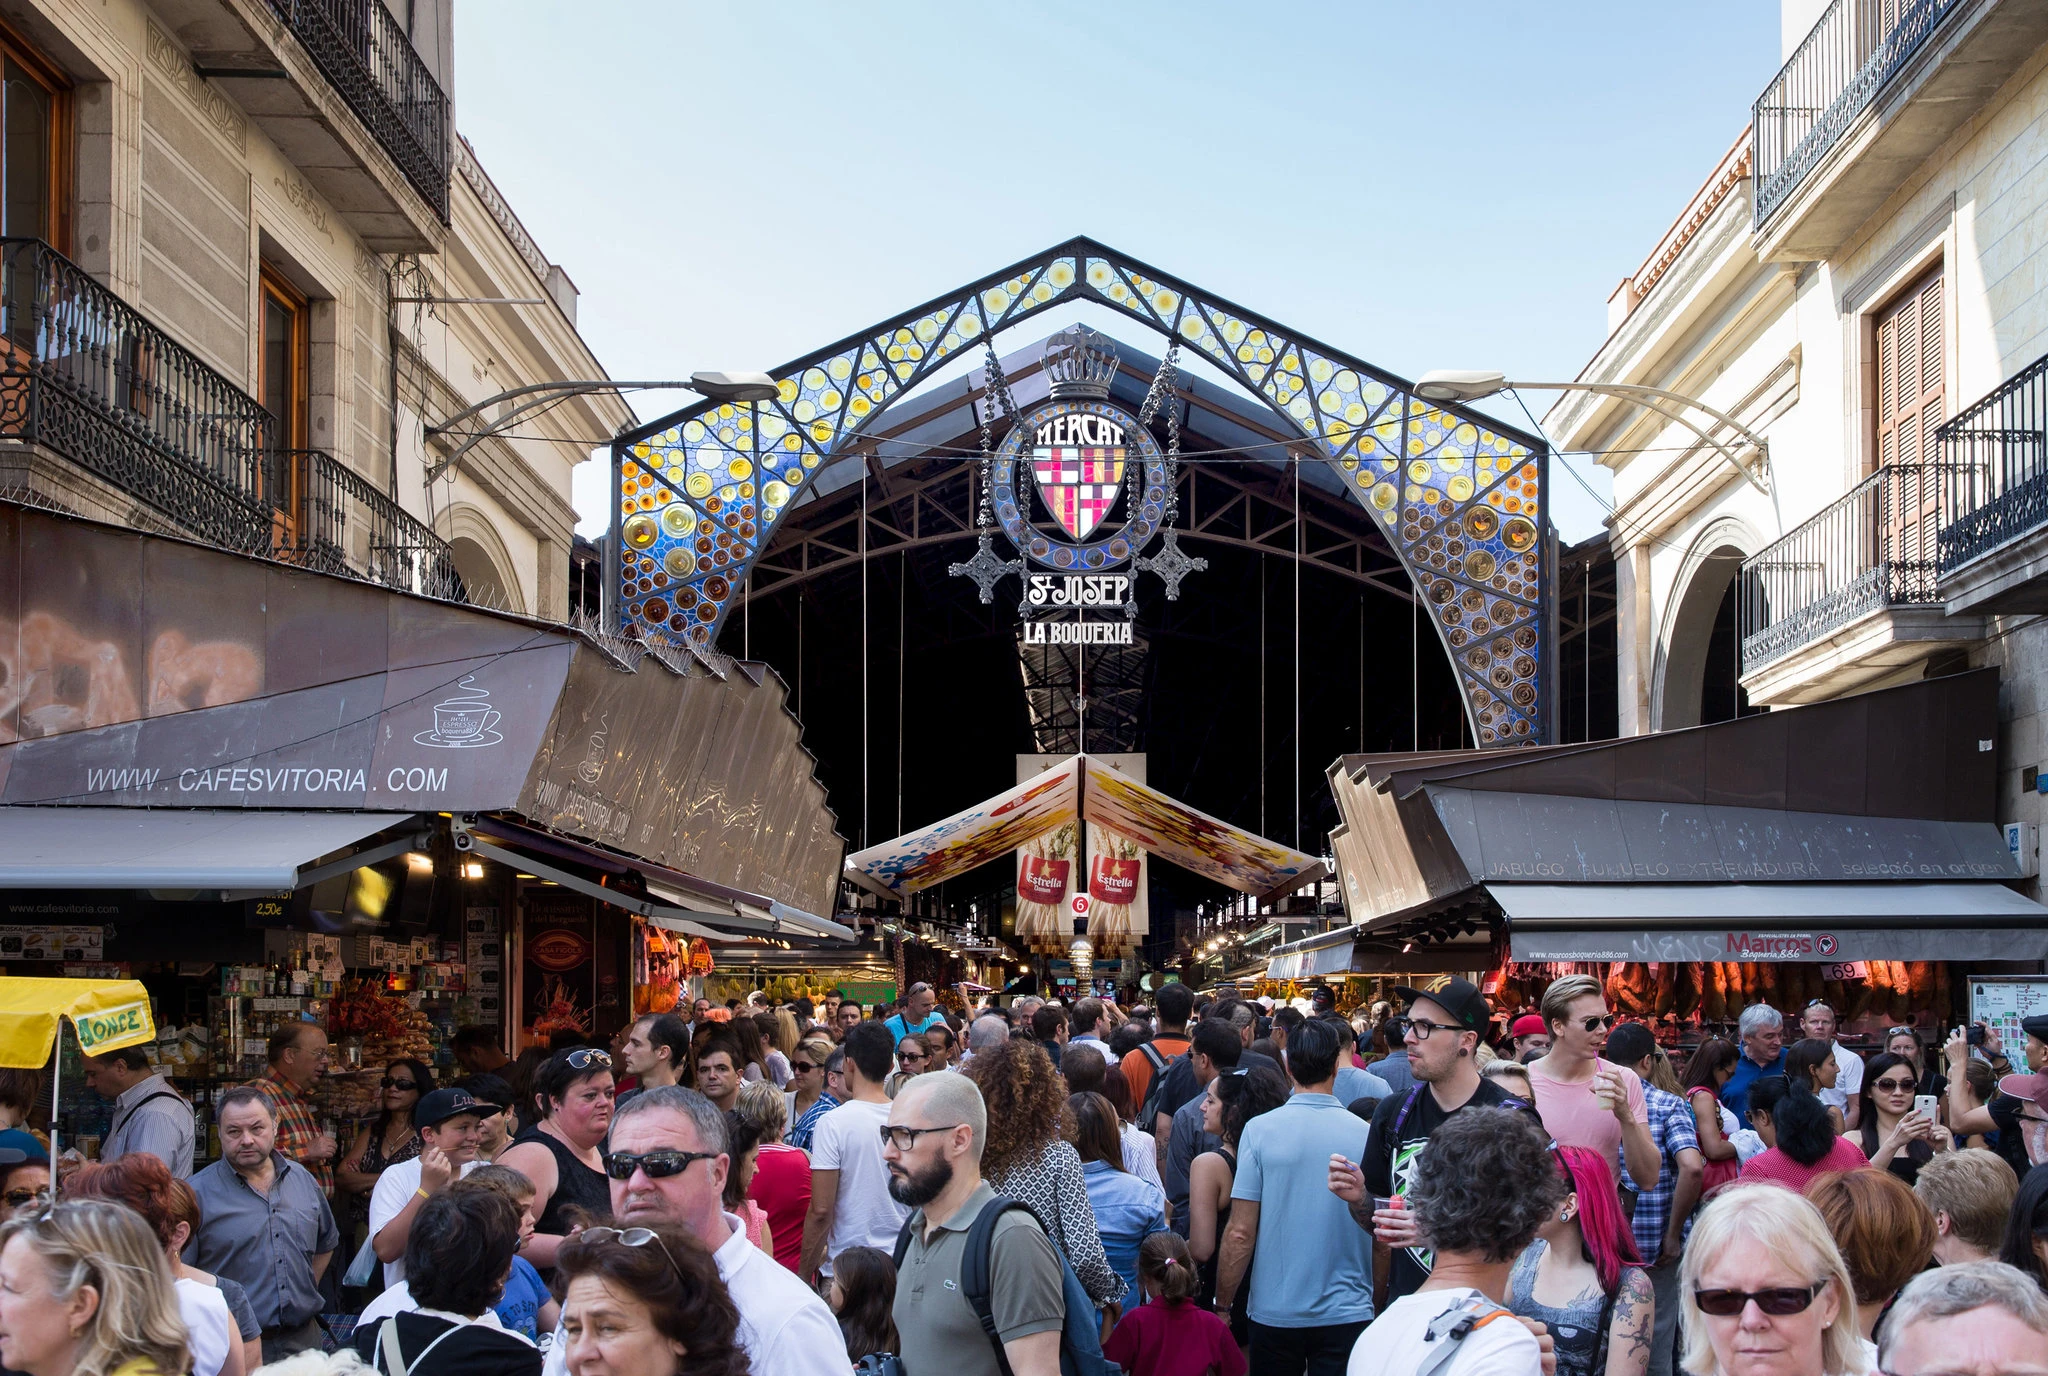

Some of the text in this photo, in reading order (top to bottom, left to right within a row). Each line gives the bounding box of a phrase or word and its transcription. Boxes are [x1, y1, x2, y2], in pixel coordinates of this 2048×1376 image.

[1037, 414, 1124, 445] MERCAT
[1051, 576, 1129, 606] JOSEP
[1024, 622, 1133, 645] LA BOQUERIA
[179, 768, 366, 792] CAFESVITORIA
[387, 768, 448, 792] COM
[1490, 863, 1564, 876] JABUGO
[1672, 862, 1821, 877] EXTREMADURA
[1026, 872, 1062, 888] Estrella
[1097, 872, 1133, 888] Estrella
[9, 904, 119, 913] www.cafesvitoria.com
[1076, 899, 1085, 911] 6
[1726, 933, 1813, 953] Marcos
[1529, 950, 1628, 960] www.marcosboqueria886.com
[1831, 964, 1856, 979] 69
